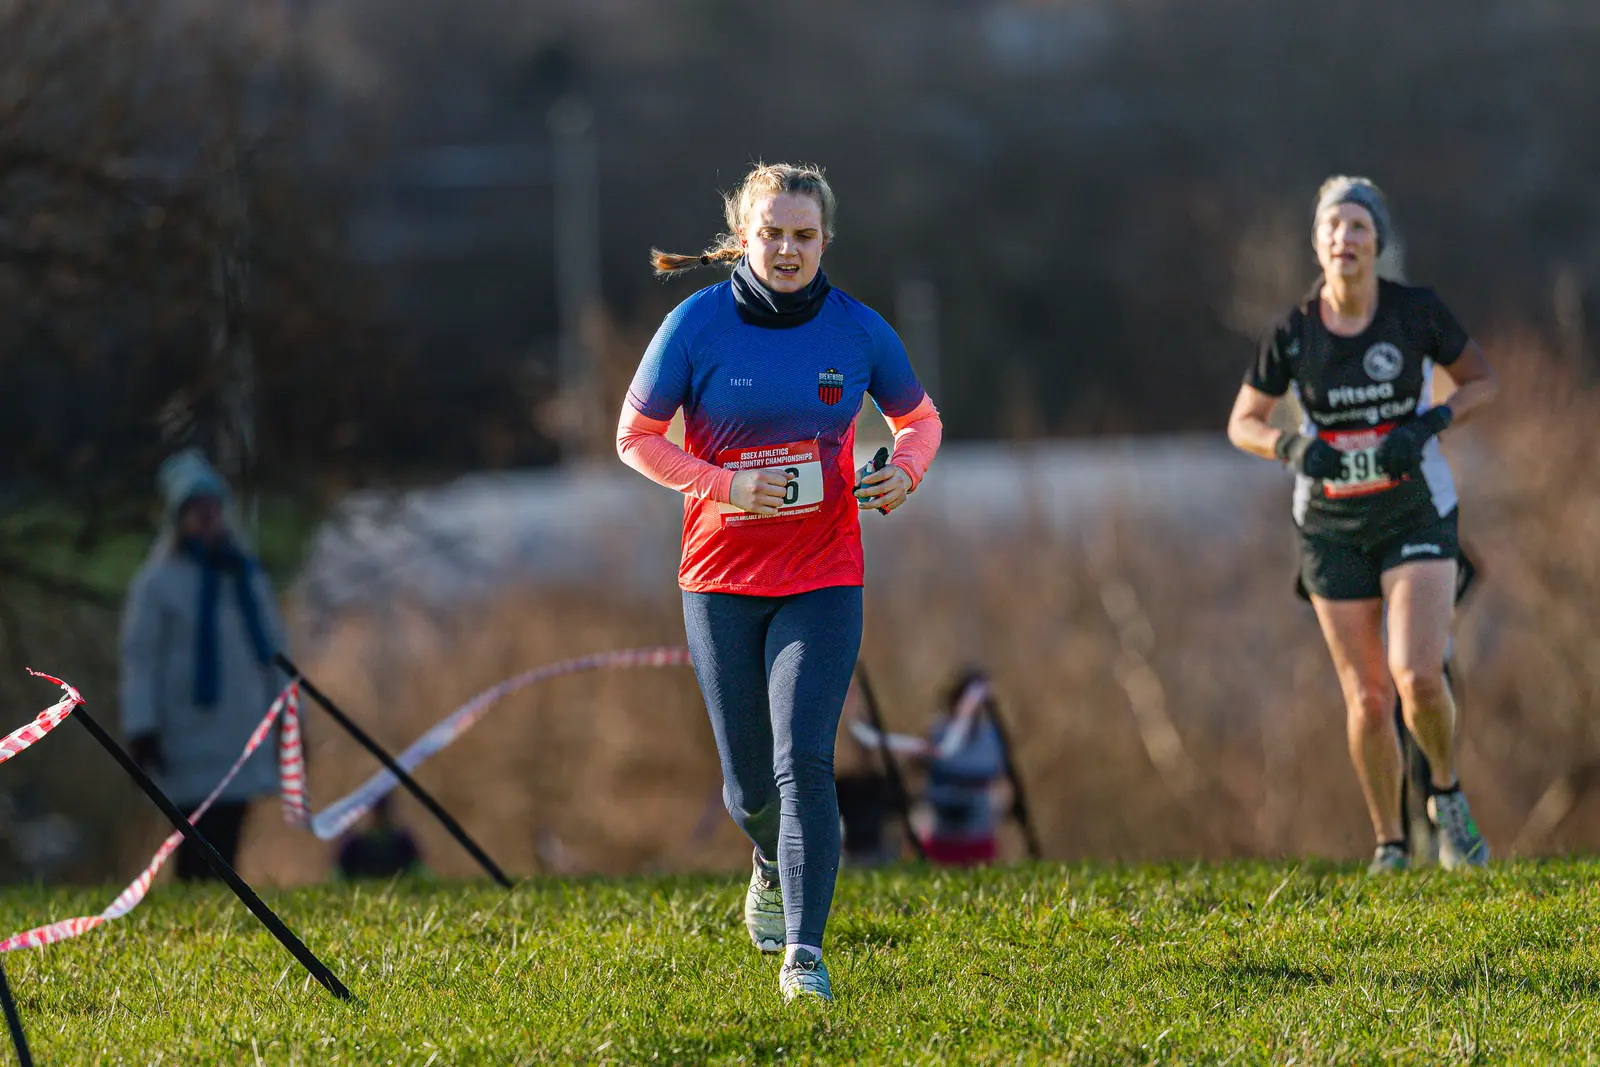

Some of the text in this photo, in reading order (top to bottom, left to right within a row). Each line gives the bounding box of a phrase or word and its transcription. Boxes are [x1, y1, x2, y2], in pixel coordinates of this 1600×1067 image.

[730, 378, 753, 387] TACTIC
[1327, 382, 1395, 408] Pitsea
[723, 452, 813, 469] CROSS COUNTRY CHAMPIONSHIPS
[740, 447, 789, 460] ESSEX ATHLETICS
